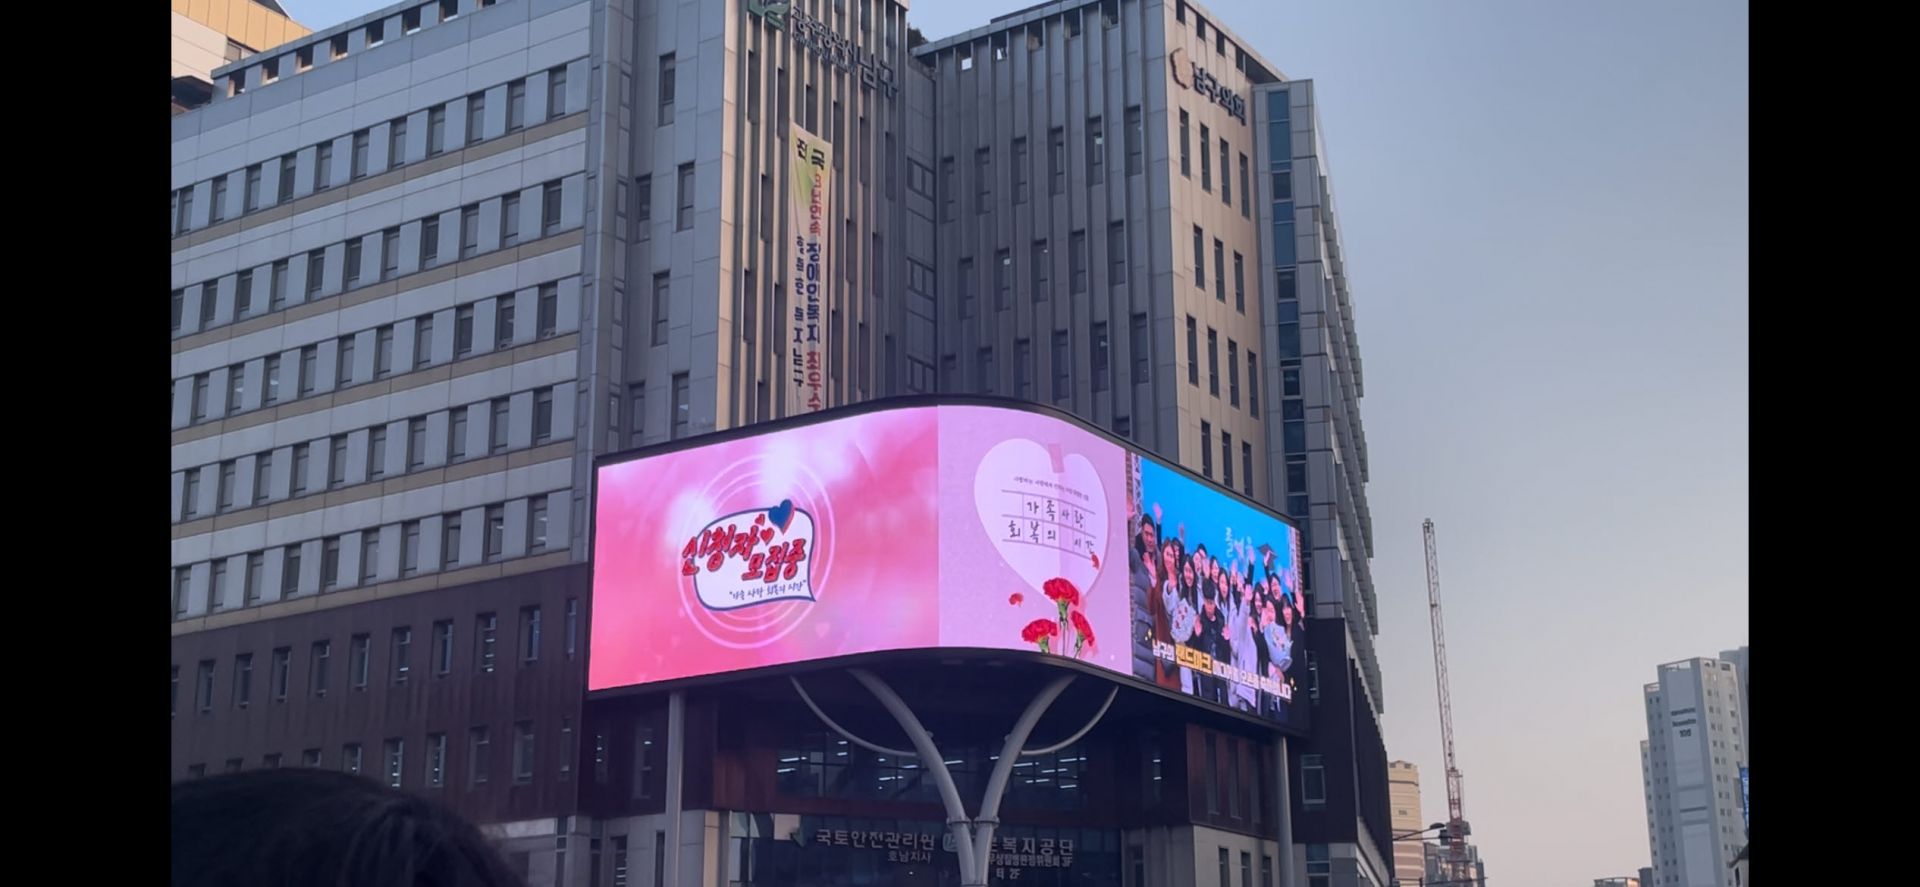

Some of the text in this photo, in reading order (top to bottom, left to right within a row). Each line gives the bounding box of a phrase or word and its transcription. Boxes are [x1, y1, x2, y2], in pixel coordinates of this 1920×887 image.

[857, 46, 898, 99] 남구
[1191, 61, 1246, 126] 남구의회
[806, 242, 821, 343] 장애인복지
[1008, 520, 1056, 544] 회복의
[682, 524, 759, 576] 신청자
[741, 538, 806, 583] 모집중
[1152, 640, 1174, 662] 남구의
[816, 828, 935, 850] 국토안전관리원
[887, 851, 931, 864] 호남지사
[1009, 868, 1021, 880] 2F
